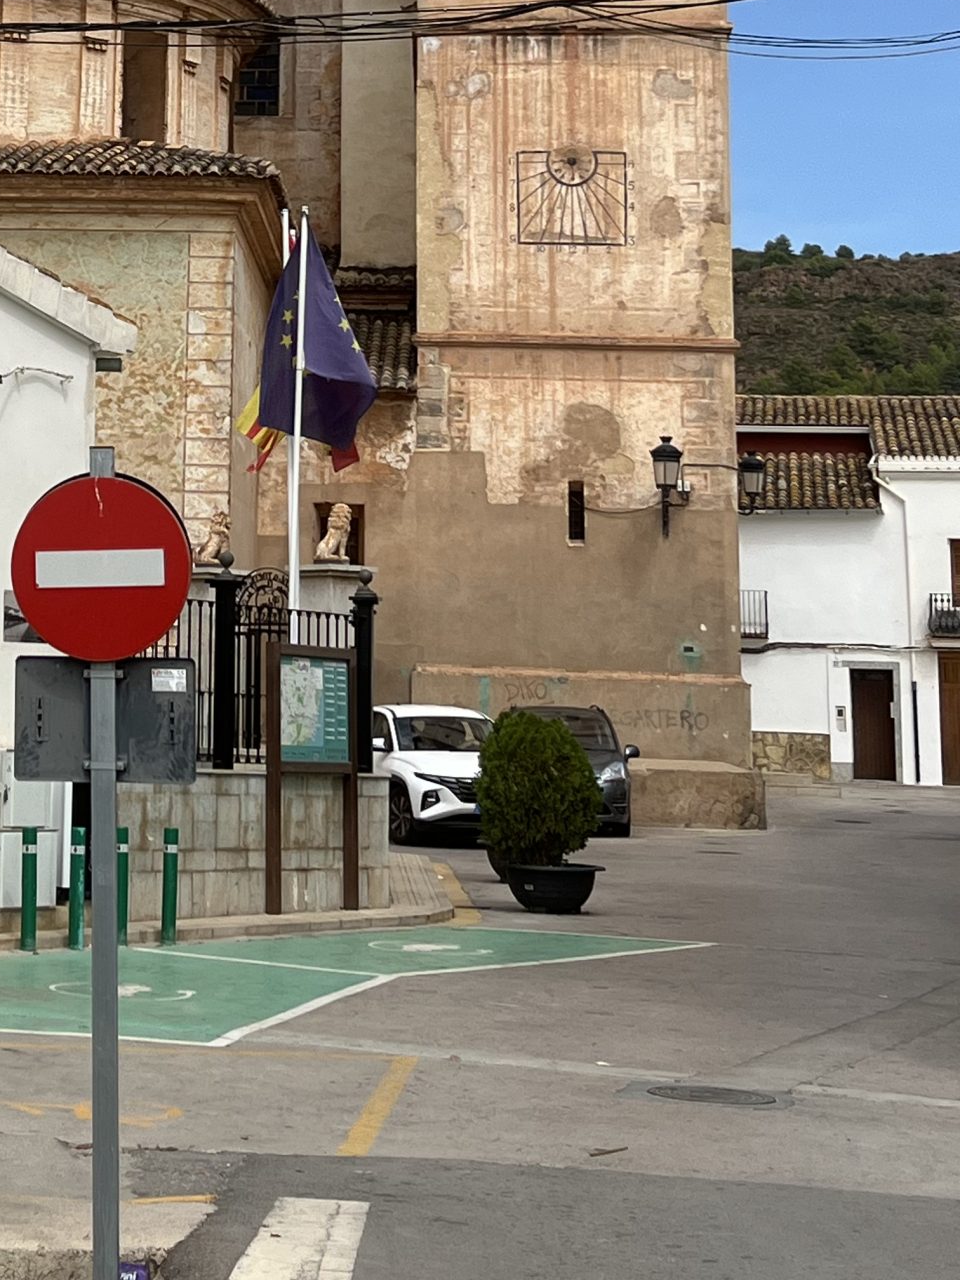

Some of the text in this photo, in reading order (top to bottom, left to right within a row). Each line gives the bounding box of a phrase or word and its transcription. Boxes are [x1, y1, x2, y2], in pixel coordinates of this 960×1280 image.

[628, 181, 635, 190] 5
[509, 203, 515, 212] 8
[628, 202, 635, 211] 4
[628, 237, 635, 246] 3
[537, 245, 545, 253] 10
[568, 245, 577, 254] 12
[606, 246, 612, 254] 2
